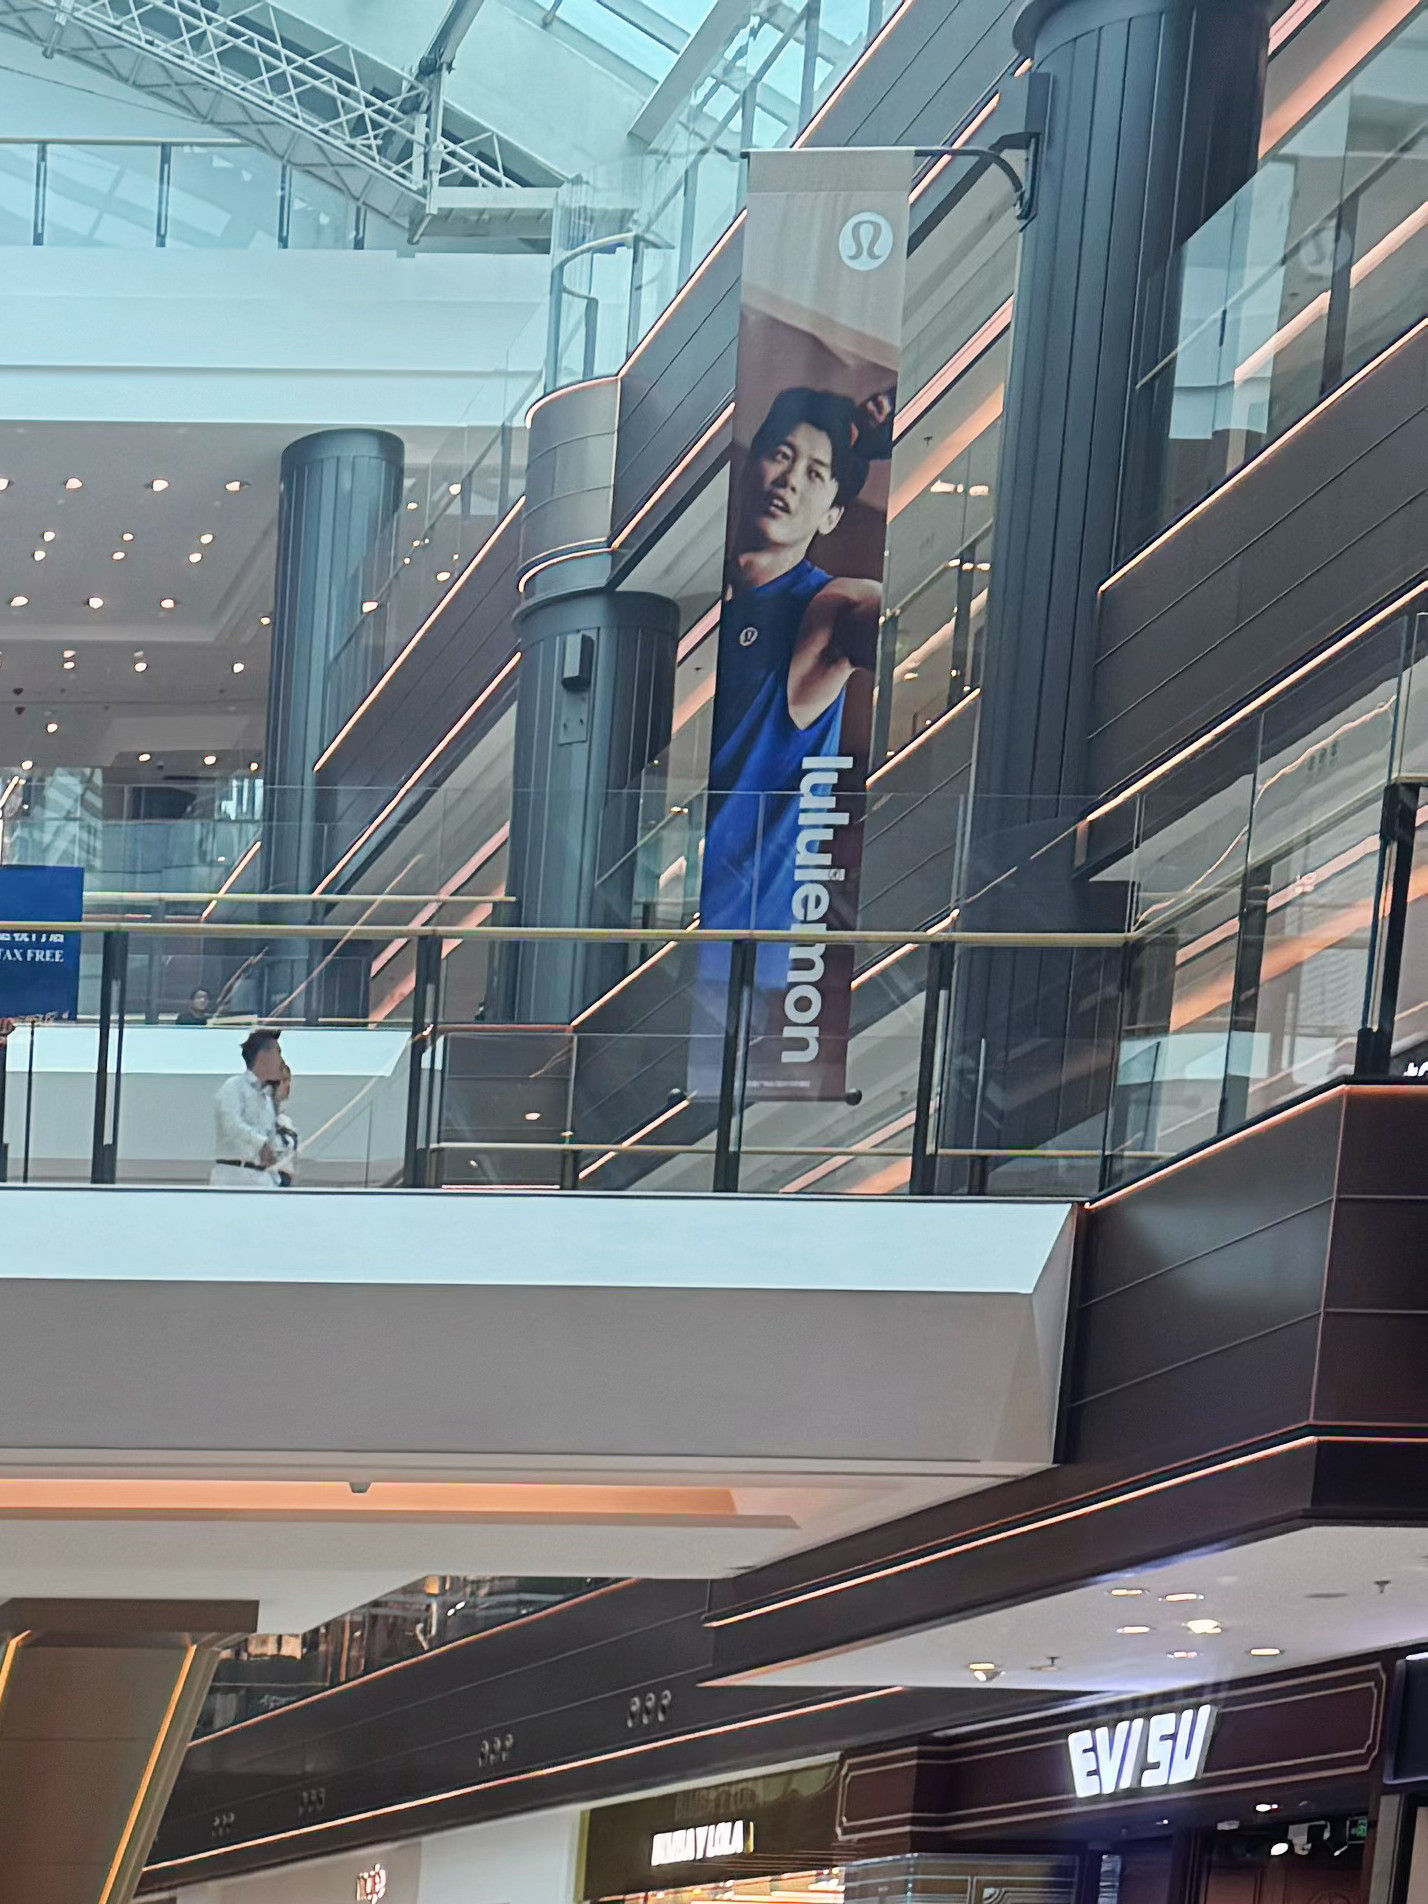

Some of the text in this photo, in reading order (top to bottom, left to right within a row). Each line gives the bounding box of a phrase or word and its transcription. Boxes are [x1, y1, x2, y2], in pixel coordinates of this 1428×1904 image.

[26, 949, 65, 962] FREE
[781, 755, 854, 1064] lululemon
[1067, 1704, 1214, 1799] EVISU
